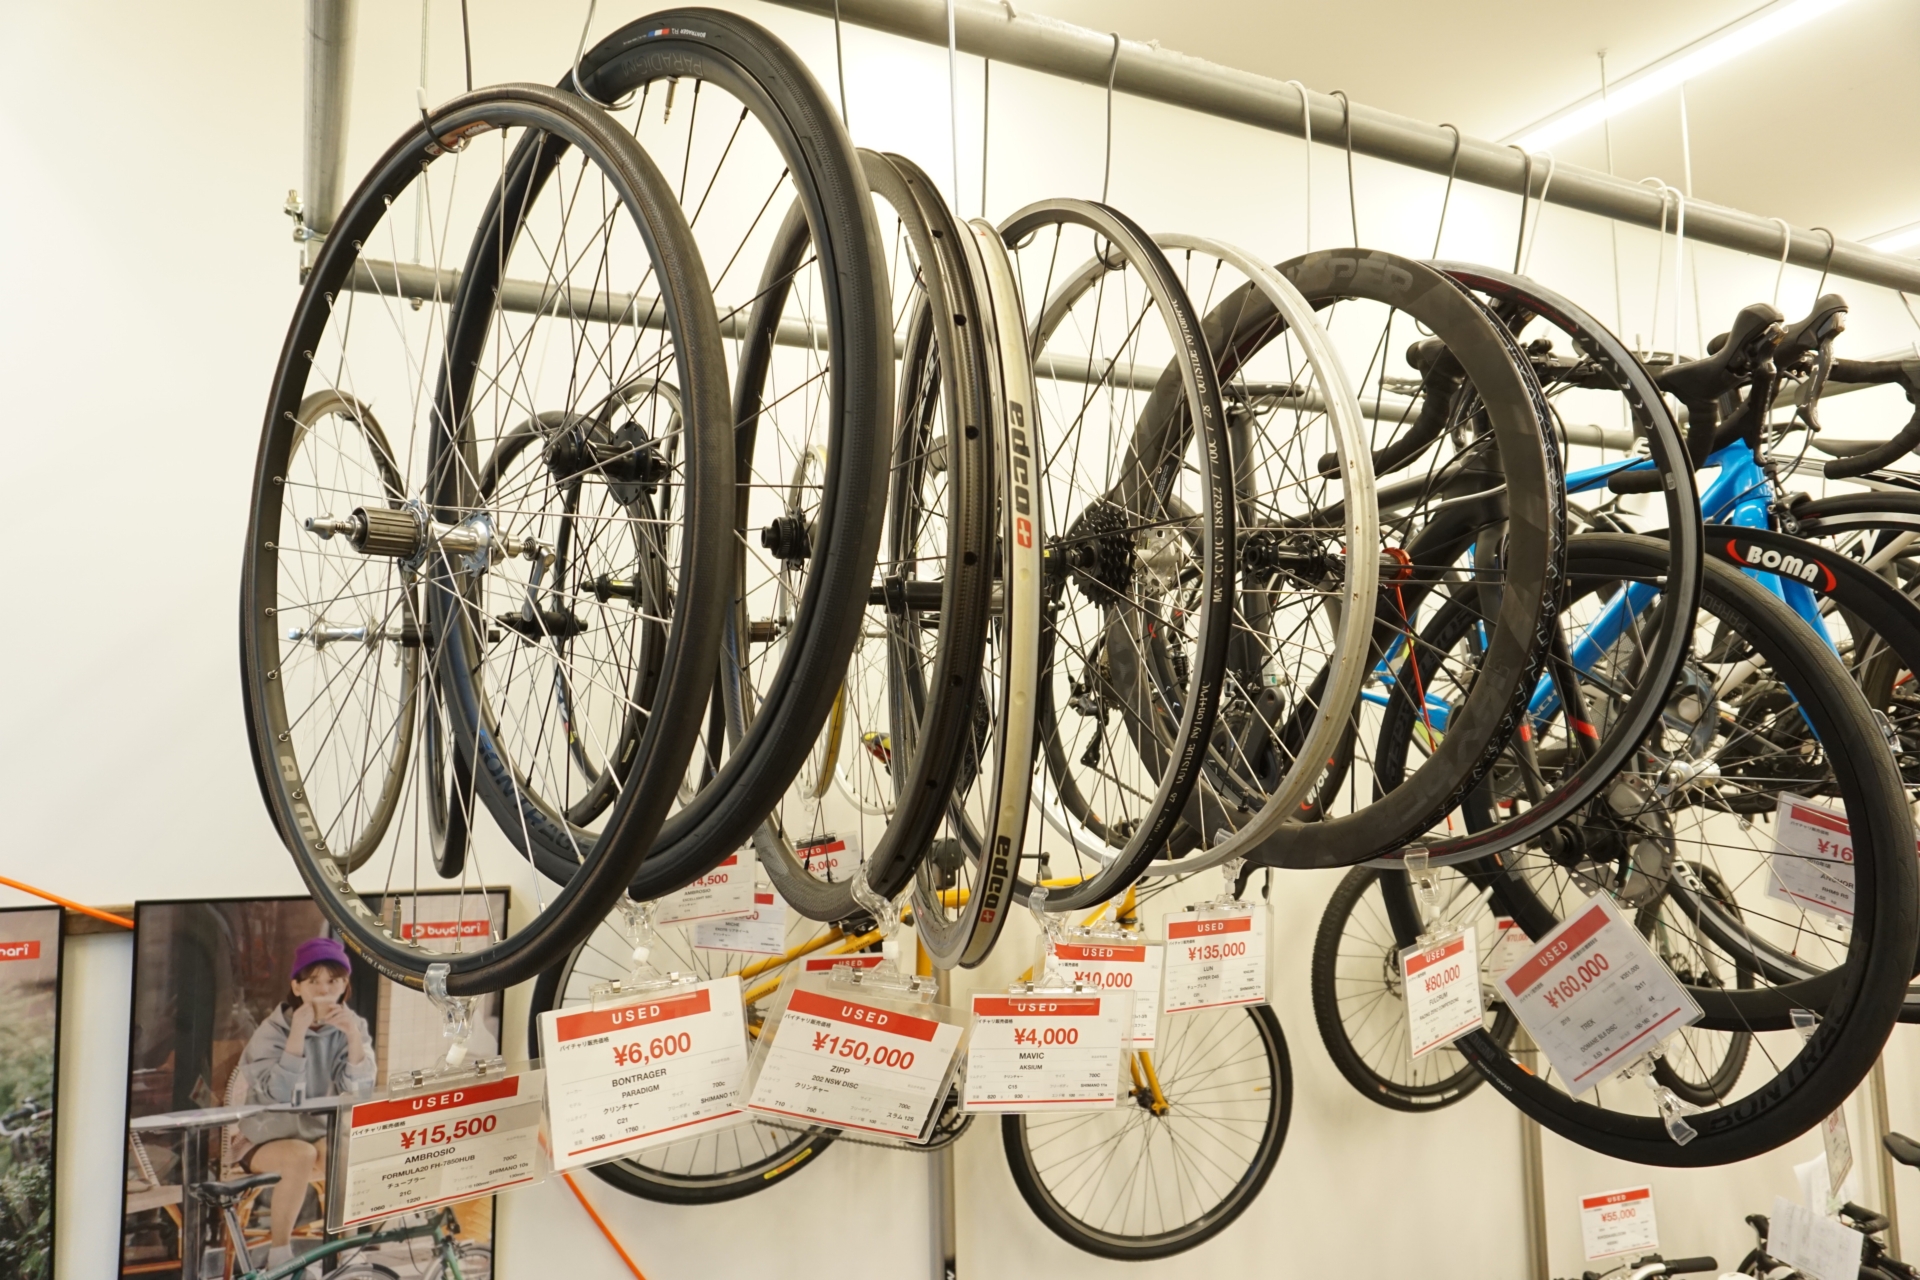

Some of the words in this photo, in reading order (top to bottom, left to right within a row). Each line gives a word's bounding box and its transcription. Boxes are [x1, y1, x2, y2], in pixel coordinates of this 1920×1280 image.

[622, 51, 703, 77] PARADIGM
[1190, 349, 1206, 394] OUTSIDE
[1009, 400, 1031, 516] edco
[1746, 545, 1819, 583] BOMA
[984, 835, 1011, 909] edco
[684, 888, 711, 896] AMBROSIO
[427, 922, 481, 936] buychari
[1198, 923, 1224, 932] USED
[1082, 948, 1113, 957] USED
[1189, 942, 1245, 960] ¥135,000
[1426, 948, 1445, 963] USED
[1539, 940, 1568, 967] USED
[1075, 972, 1132, 989] ¥10,000
[1425, 964, 1461, 993] ¥80,000
[1543, 952, 1609, 1009] ¥160,000
[1429, 992, 1448, 1005] FULCRUM
[611, 1005, 661, 1024] USED
[1017, 1003, 1057, 1012] USED
[841, 1006, 889, 1025] USED
[1580, 1019, 1596, 1031] TREK
[560, 1037, 609, 1052] バイチャリ販売価格
[1014, 1028, 1078, 1047] ¥4,000
[1580, 1037, 1599, 1053] DOMANE
[1605, 1023, 1618, 1034] DISC
[613, 1032, 691, 1066] ¥6,600
[812, 1031, 915, 1070] ¥150,000
[1019, 1052, 1044, 1060] MAVIC
[830, 1065, 850, 1074] ZIPP
[611, 1068, 667, 1088] BONTRAGER
[812, 1075, 824, 1083] 202
[824, 1077, 841, 1087] NSW
[842, 1080, 859, 1090] DISC
[621, 1084, 660, 1099] PARADIGM
[794, 1082, 829, 1093] クリンチャー
[412, 1091, 464, 1110] USED
[700, 1093, 729, 1104] SHIMANO
[603, 1102, 639, 1115] クリンチャー
[886, 1112, 903, 1120] スラム
[616, 1117, 628, 1125] C21
[352, 1121, 406, 1137] バイチャリ販売価格
[401, 1114, 497, 1149] ¥15,500
[591, 1134, 606, 1142] 1590
[404, 1147, 456, 1164] AMBROSIO
[503, 1154, 517, 1162] 700C
[381, 1166, 429, 1181] FORMULA20
[430, 1155, 476, 1170] FH-7850HUB
[489, 1164, 518, 1176] SHIMANO
[387, 1176, 426, 1189] チューブラー
[399, 1189, 412, 1197] 21C
[406, 1196, 421, 1204] 1220
[1606, 1194, 1626, 1203] USED
[1601, 1208, 1636, 1222] ¥55,000
